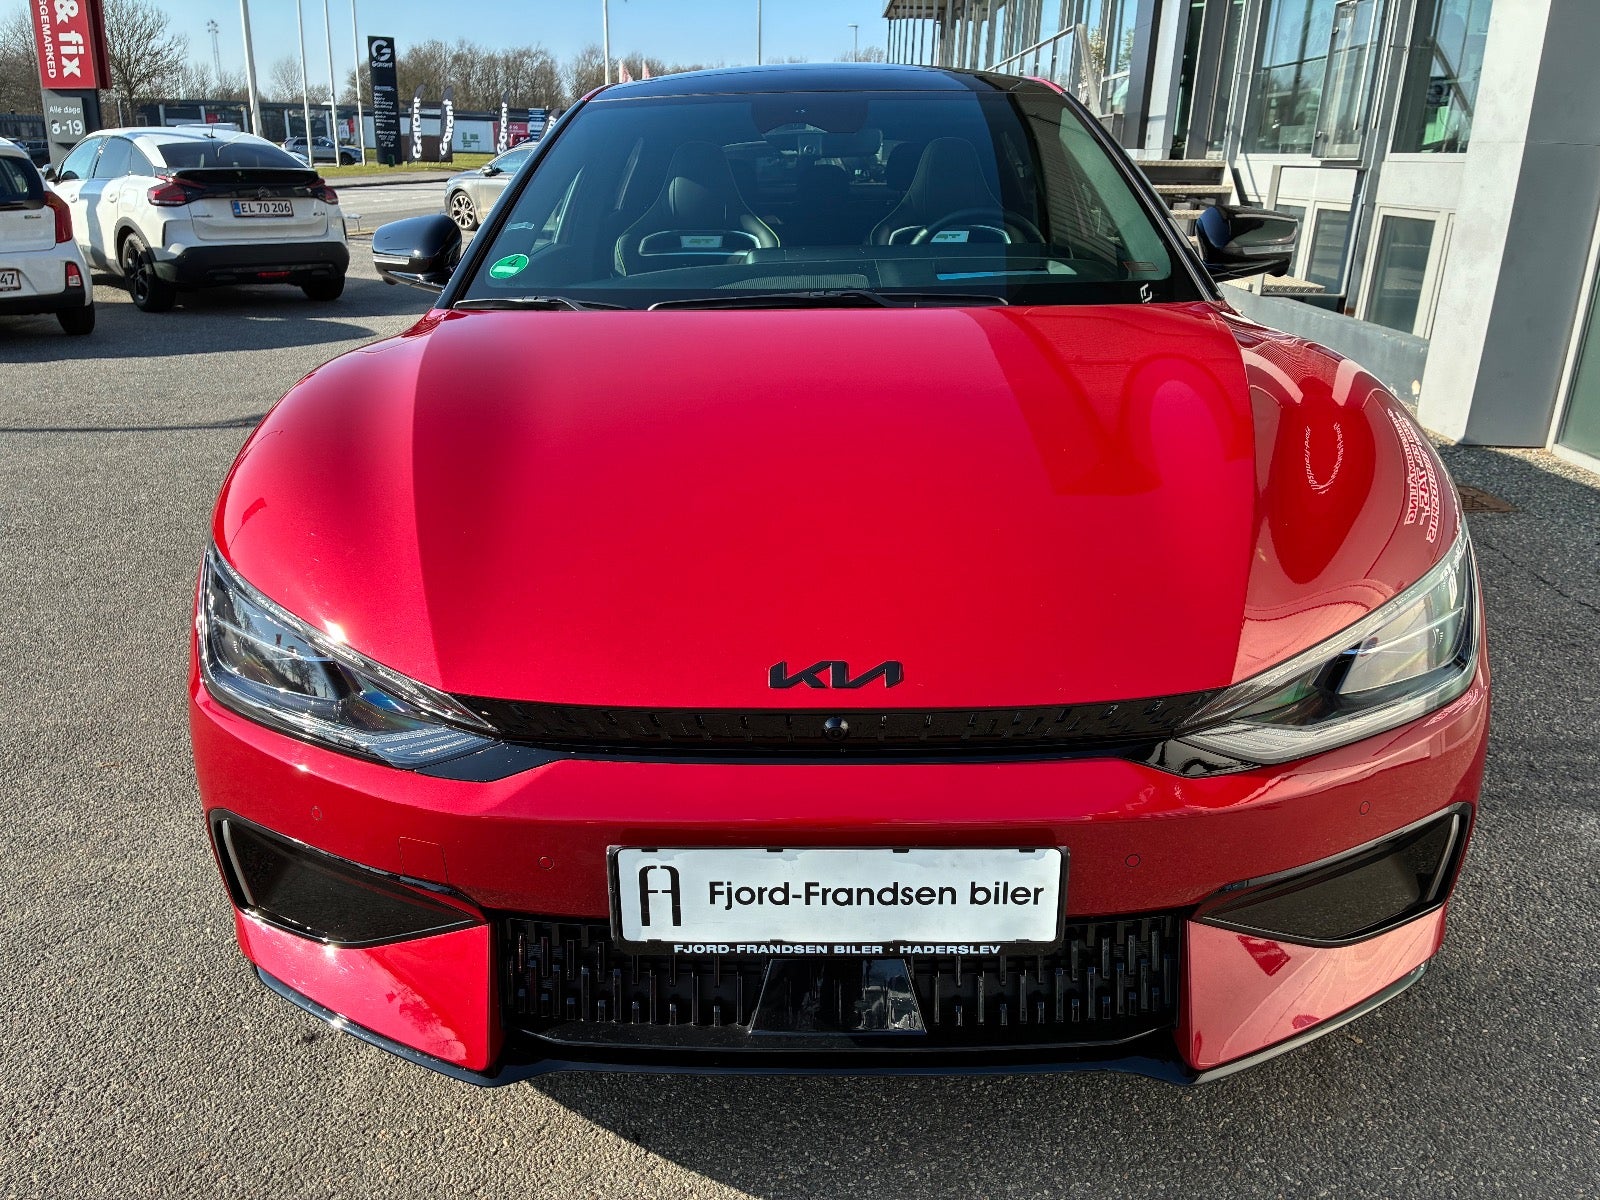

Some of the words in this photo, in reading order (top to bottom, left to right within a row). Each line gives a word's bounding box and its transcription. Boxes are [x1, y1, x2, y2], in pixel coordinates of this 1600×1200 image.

[58, 30, 85, 79] fix
[412, 96, 422, 159] Garant
[439, 98, 454, 156] Garant
[240, 202, 256, 213] EL
[258, 202, 270, 213] 70
[272, 203, 291, 213] 206
[769, 660, 904, 690] KIA
[709, 881, 957, 911] Fjord-Frandsen
[969, 881, 1045, 906] biler
[673, 944, 828, 954] FJORD-FRANDSEN
[833, 945, 883, 954] BILER
[899, 945, 1001, 955] HADERSLEV
